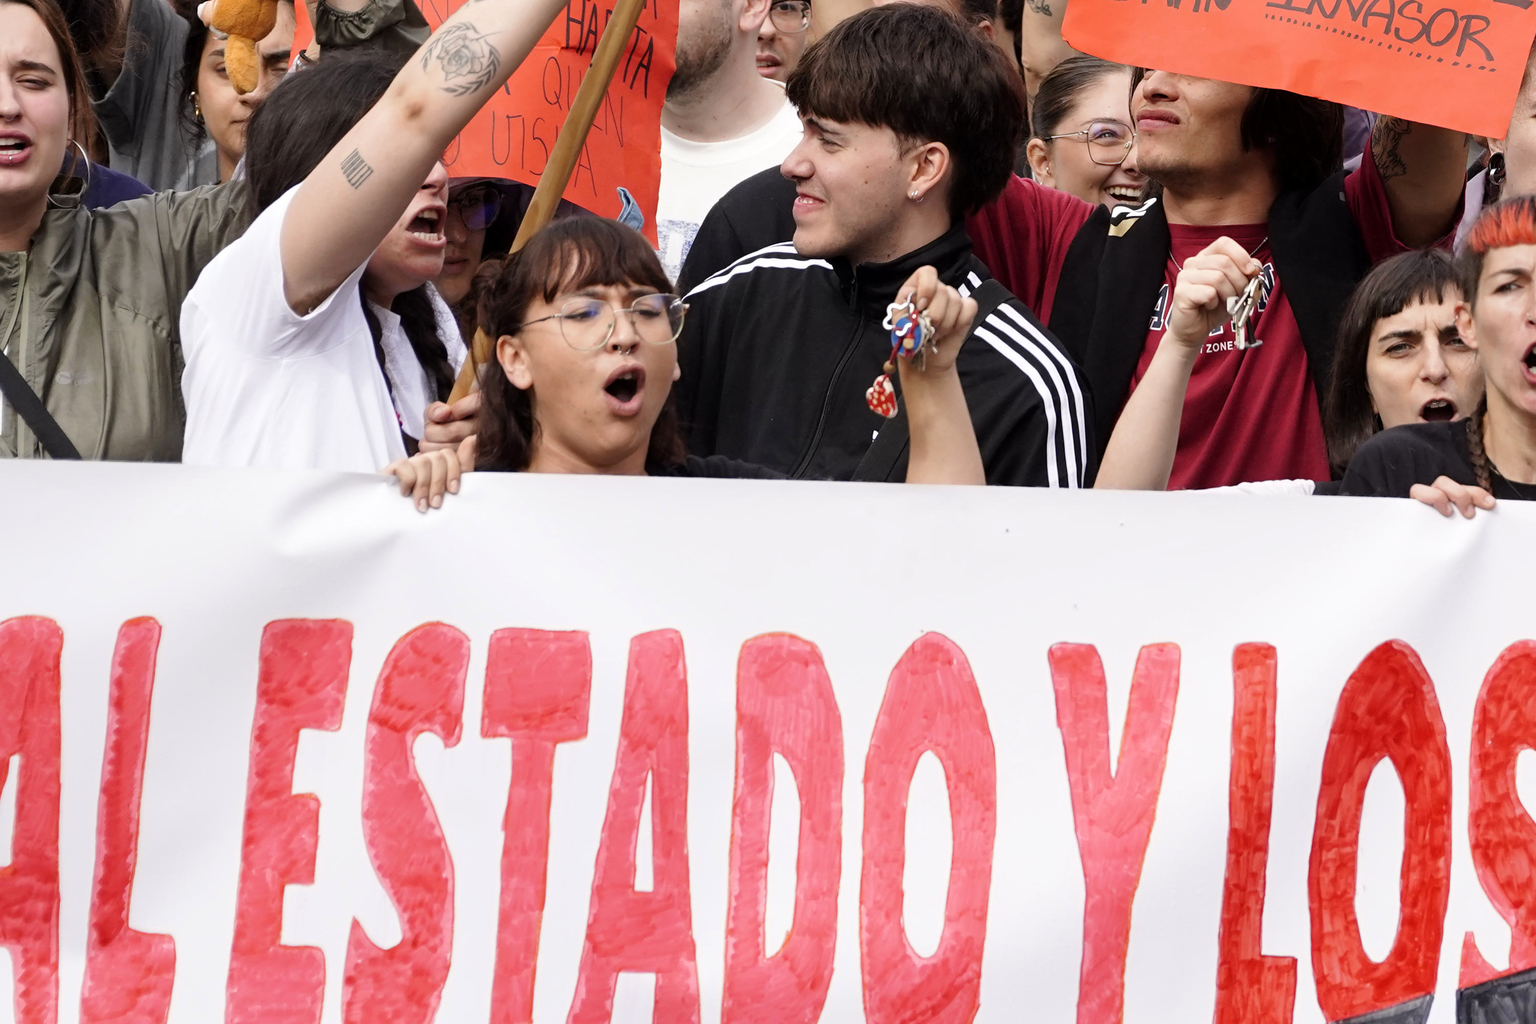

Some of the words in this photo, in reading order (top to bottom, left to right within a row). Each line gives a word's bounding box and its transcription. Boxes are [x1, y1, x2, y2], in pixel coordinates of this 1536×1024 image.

[1206, 341, 1234, 353] ZONE
[225, 618, 997, 1024] ESTADO
[1048, 641, 1181, 1024] Y
